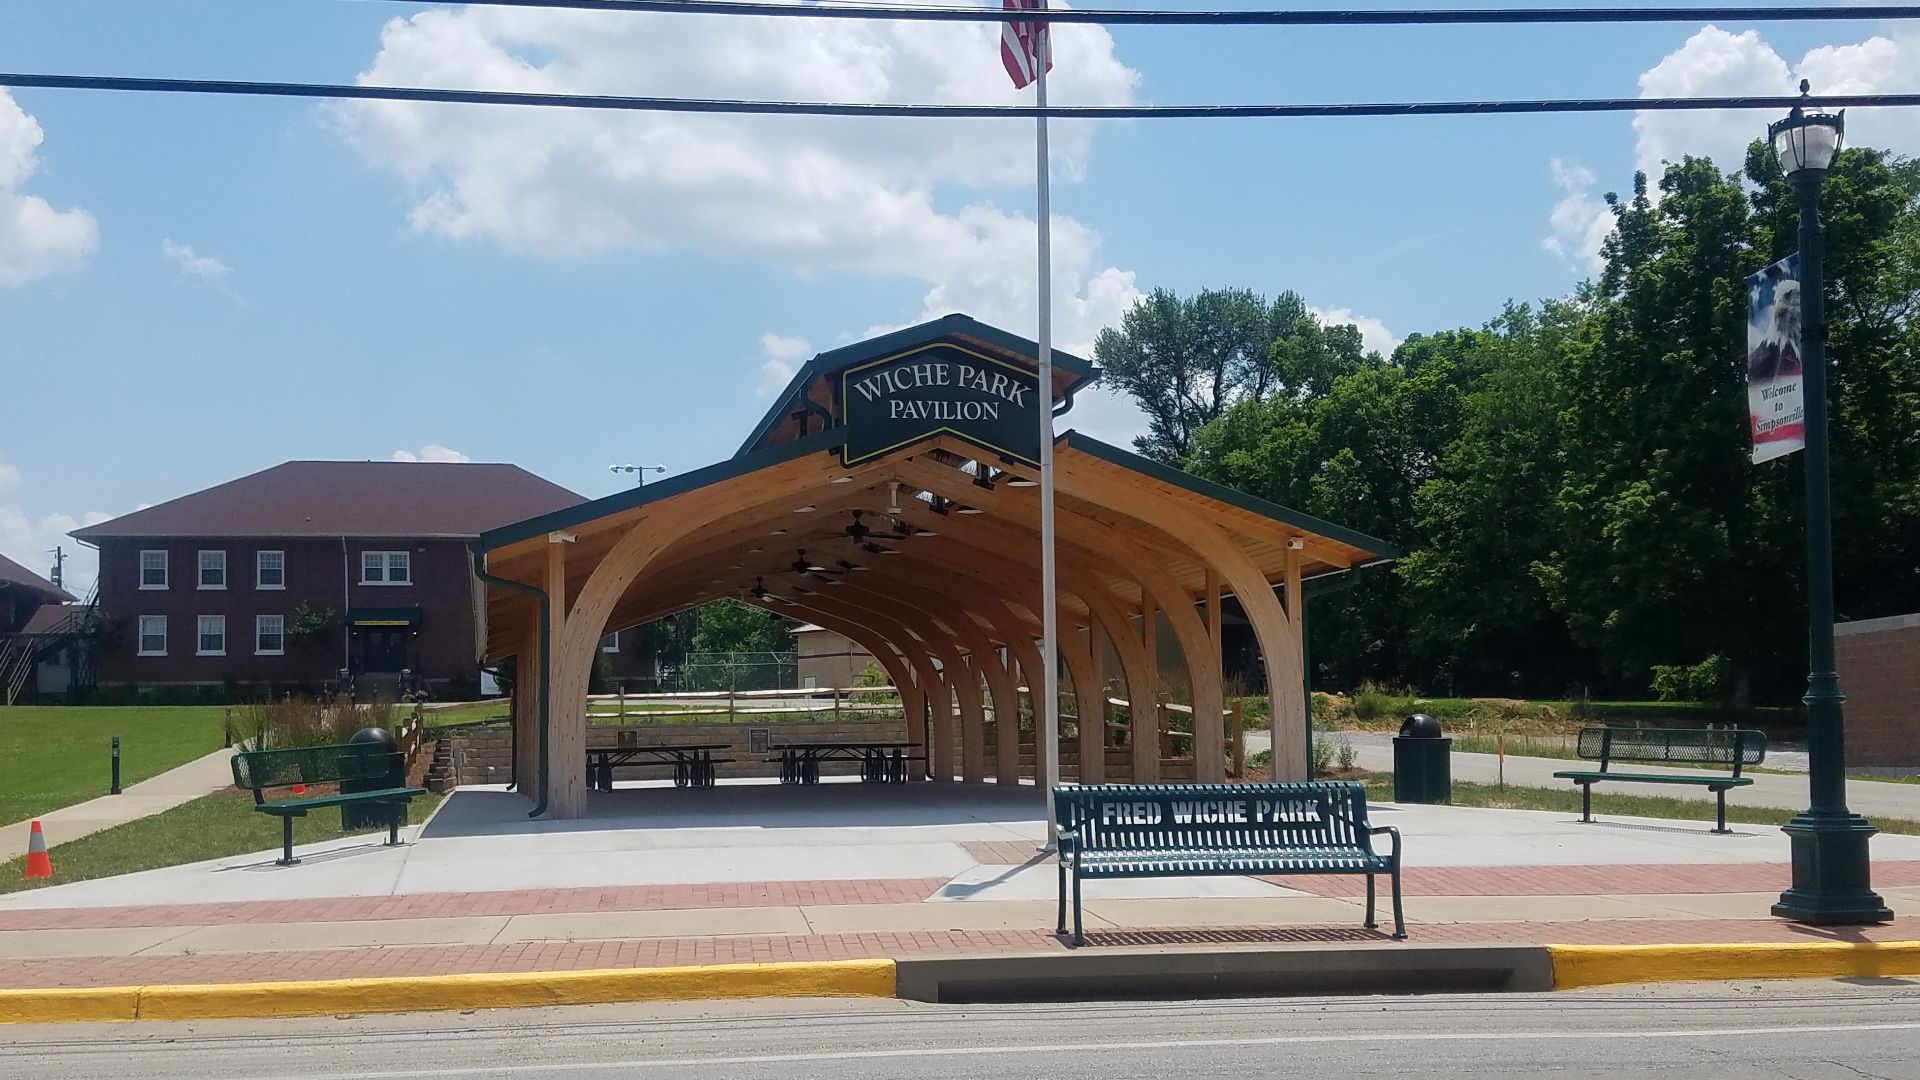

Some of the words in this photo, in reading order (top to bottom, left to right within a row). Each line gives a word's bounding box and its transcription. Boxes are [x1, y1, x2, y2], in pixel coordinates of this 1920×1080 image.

[854, 363, 950, 402] WICHE
[958, 365, 1032, 408] PARK
[1761, 382, 1797, 402] Welcome
[890, 400, 999, 420] PAVILION
[1774, 402, 1784, 412] to
[1756, 405, 1804, 433] Simpsonville
[1102, 801, 1162, 825] FRED
[1171, 800, 1248, 824] WICHE
[1255, 799, 1322, 823] PARK
